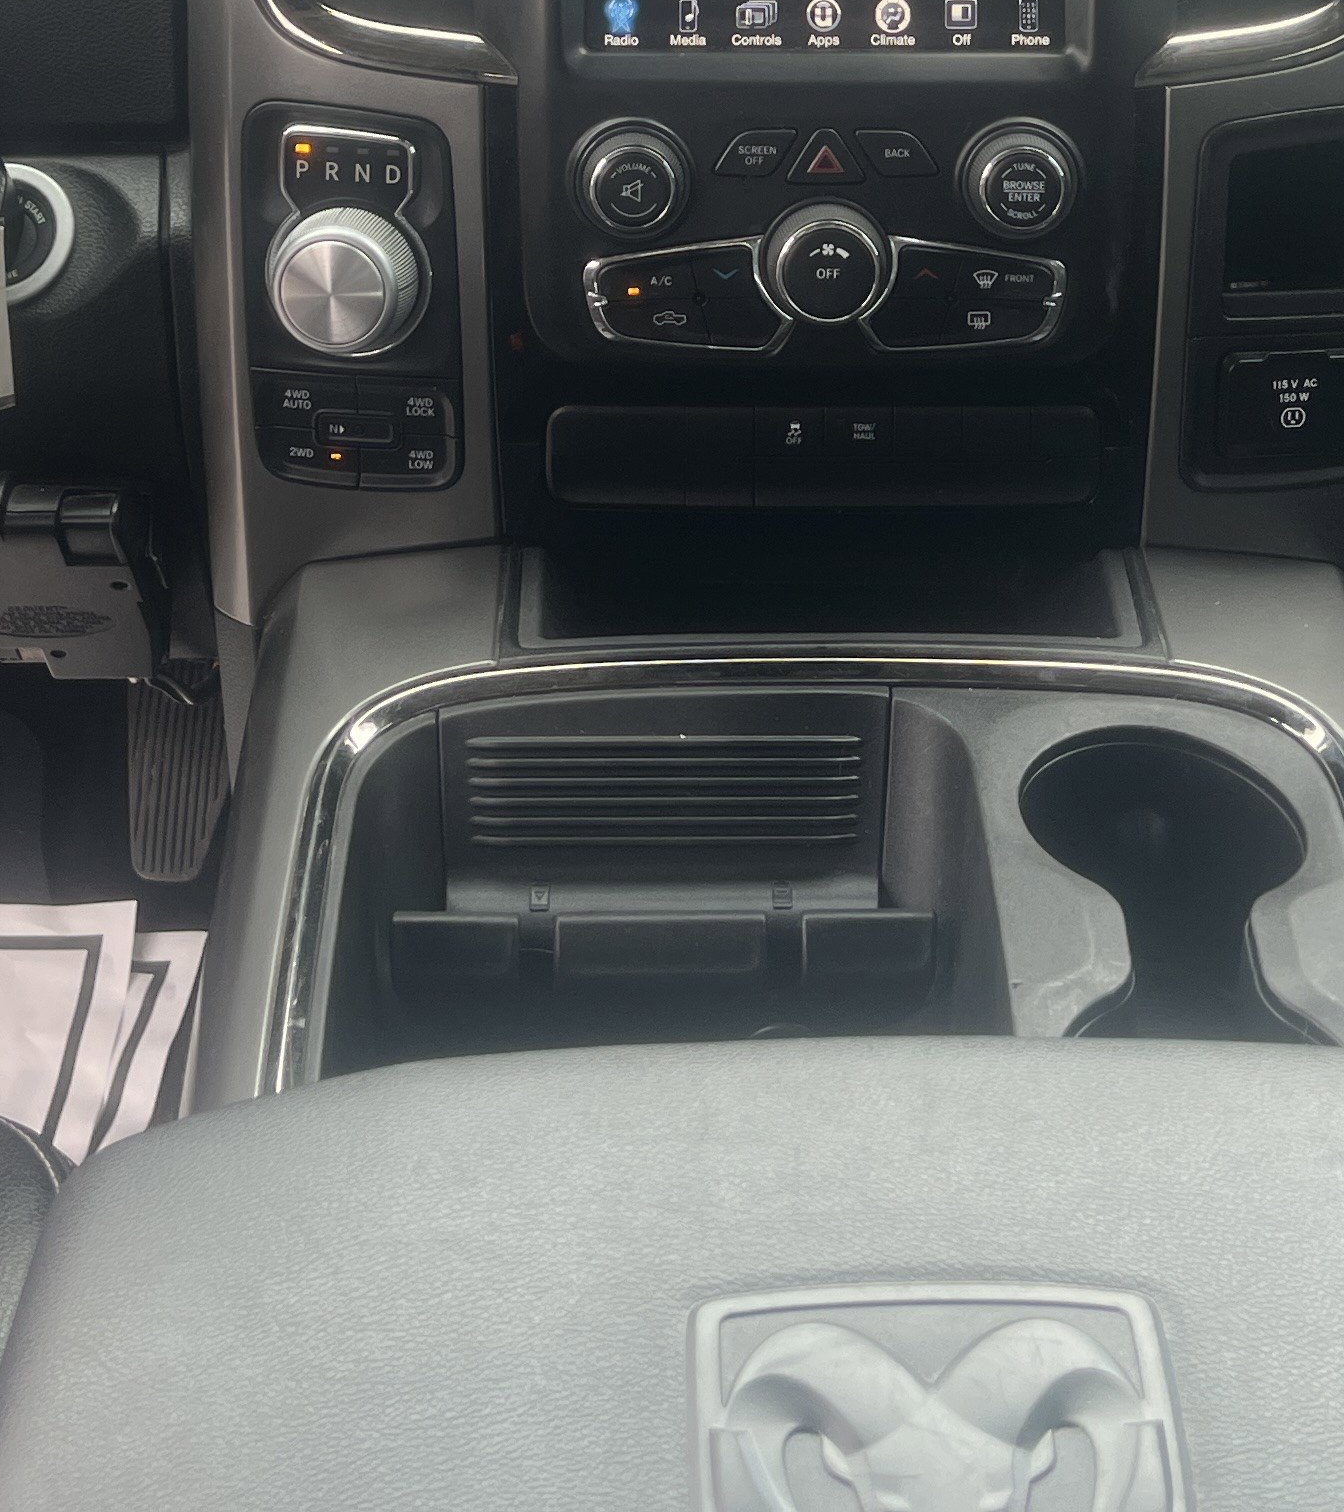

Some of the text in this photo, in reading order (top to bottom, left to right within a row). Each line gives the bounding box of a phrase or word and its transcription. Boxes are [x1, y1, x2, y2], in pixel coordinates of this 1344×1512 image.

[604, 34, 639, 46] Radio
[670, 34, 707, 46] Media
[731, 34, 782, 46] Controls
[807, 34, 840, 48] Apps
[870, 34, 916, 46] Climate
[952, 34, 972, 46] Off
[1011, 34, 1051, 46] Phone
[738, 145, 777, 155] SCREEN
[884, 148, 911, 159] BACK
[744, 155, 764, 165] OFF
[295, 159, 401, 185] P R N D
[616, 162, 652, 175] VOLUME
[1012, 162, 1037, 172] TUNE
[1003, 180, 1045, 190] BROWSE
[1008, 192, 1041, 203] ENTER
[24, 200, 46, 225] START
[1007, 208, 1039, 220] SCROLL
[816, 267, 841, 280] OFF
[1004, 274, 1034, 283] FRONT
[650, 275, 673, 286] A/C
[1272, 378, 1318, 390] 115 V AC
[284, 389, 310, 399] 4WD
[1279, 392, 1310, 403] 150 W
[283, 399, 312, 410] AUTO
[407, 397, 433, 407] 4WD
[406, 407, 435, 417] LOCK
[785, 436, 802, 445] OFF
[289, 446, 314, 458] 2WD
[408, 450, 434, 459] 4WD
[408, 460, 434, 470] LOW
